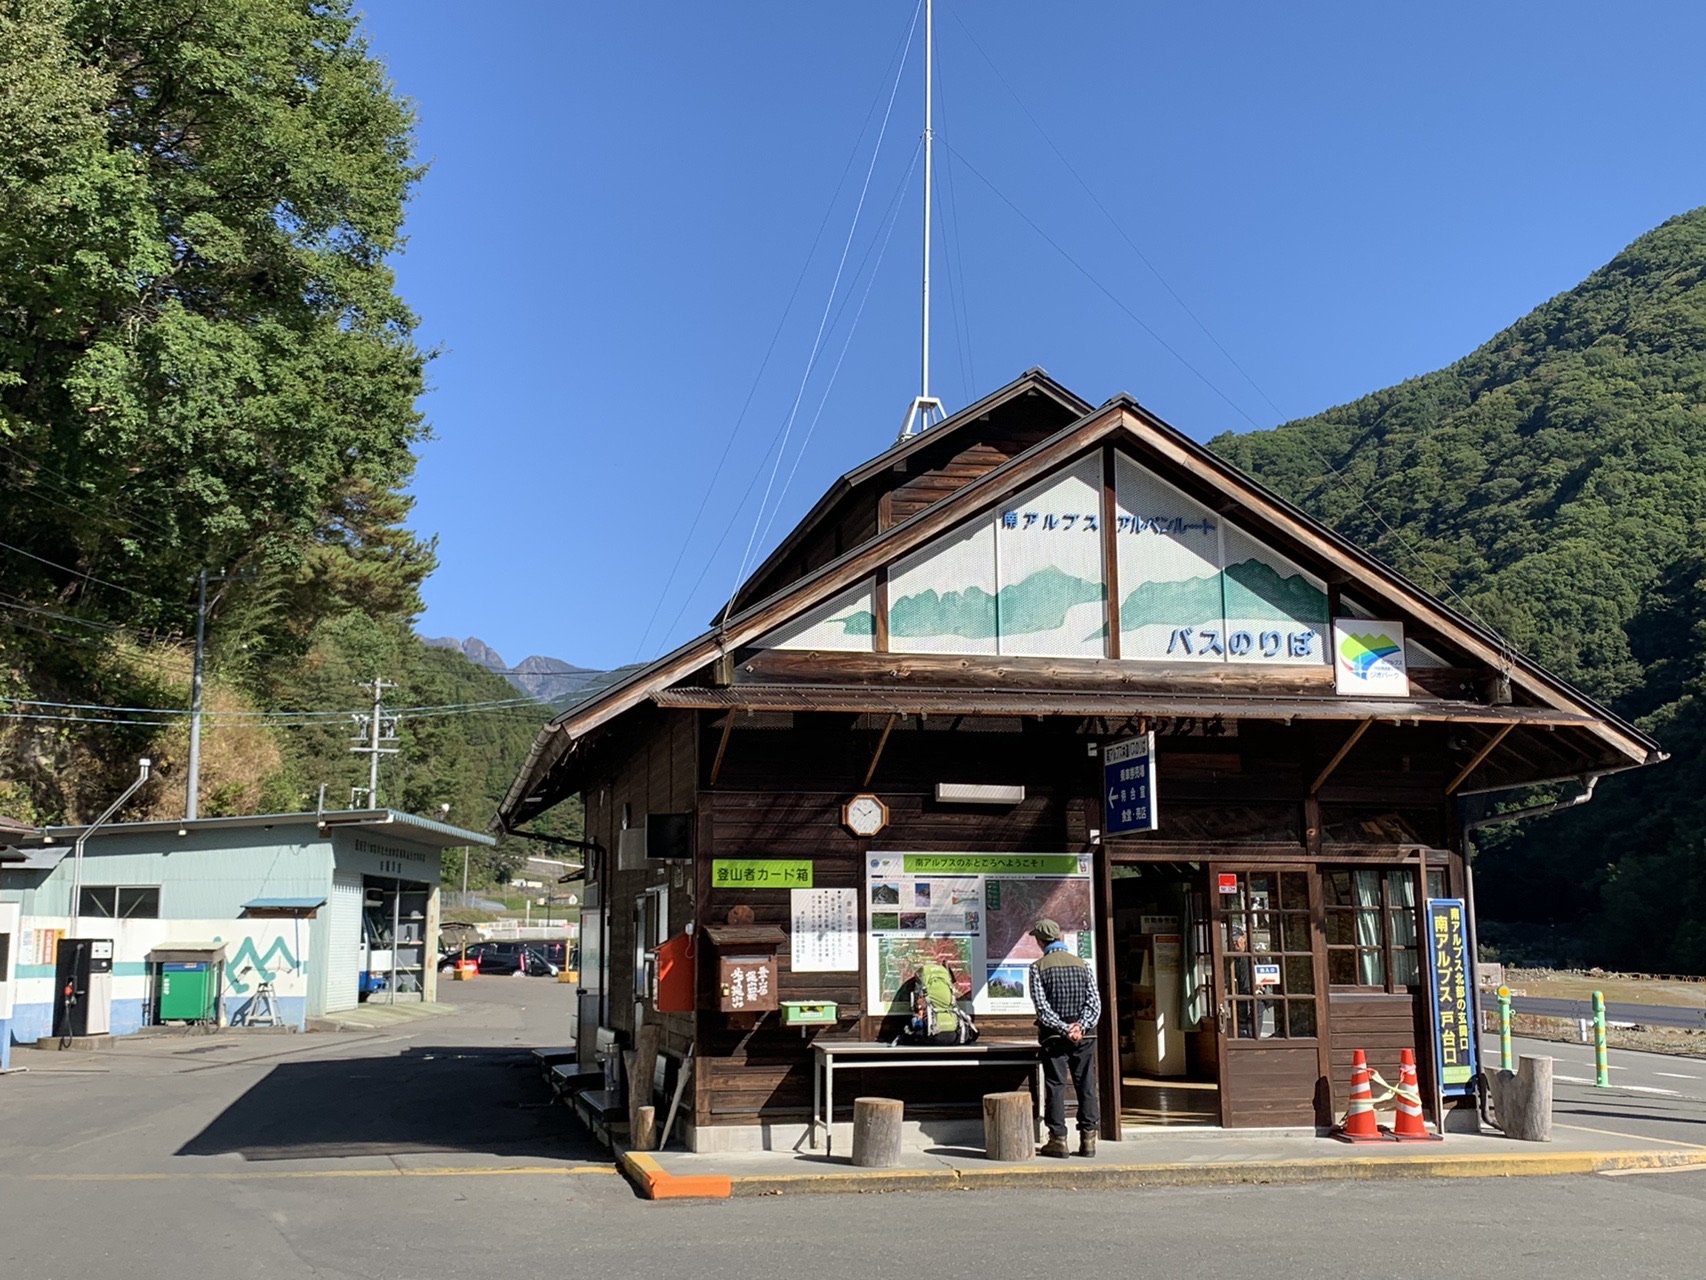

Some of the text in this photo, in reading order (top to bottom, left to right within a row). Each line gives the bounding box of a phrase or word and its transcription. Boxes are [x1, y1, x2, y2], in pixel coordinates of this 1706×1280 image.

[1001, 511, 1216, 535] 南アルプス アルペンルート
[1166, 627, 1315, 658] バスのりば
[717, 867, 809, 882] 登山者カード箱
[1434, 915, 1453, 1003] 南アルプス
[1450, 908, 1469, 1050] 南アルプス北部の玄関口
[1440, 1010, 1457, 1064] 戸台口
